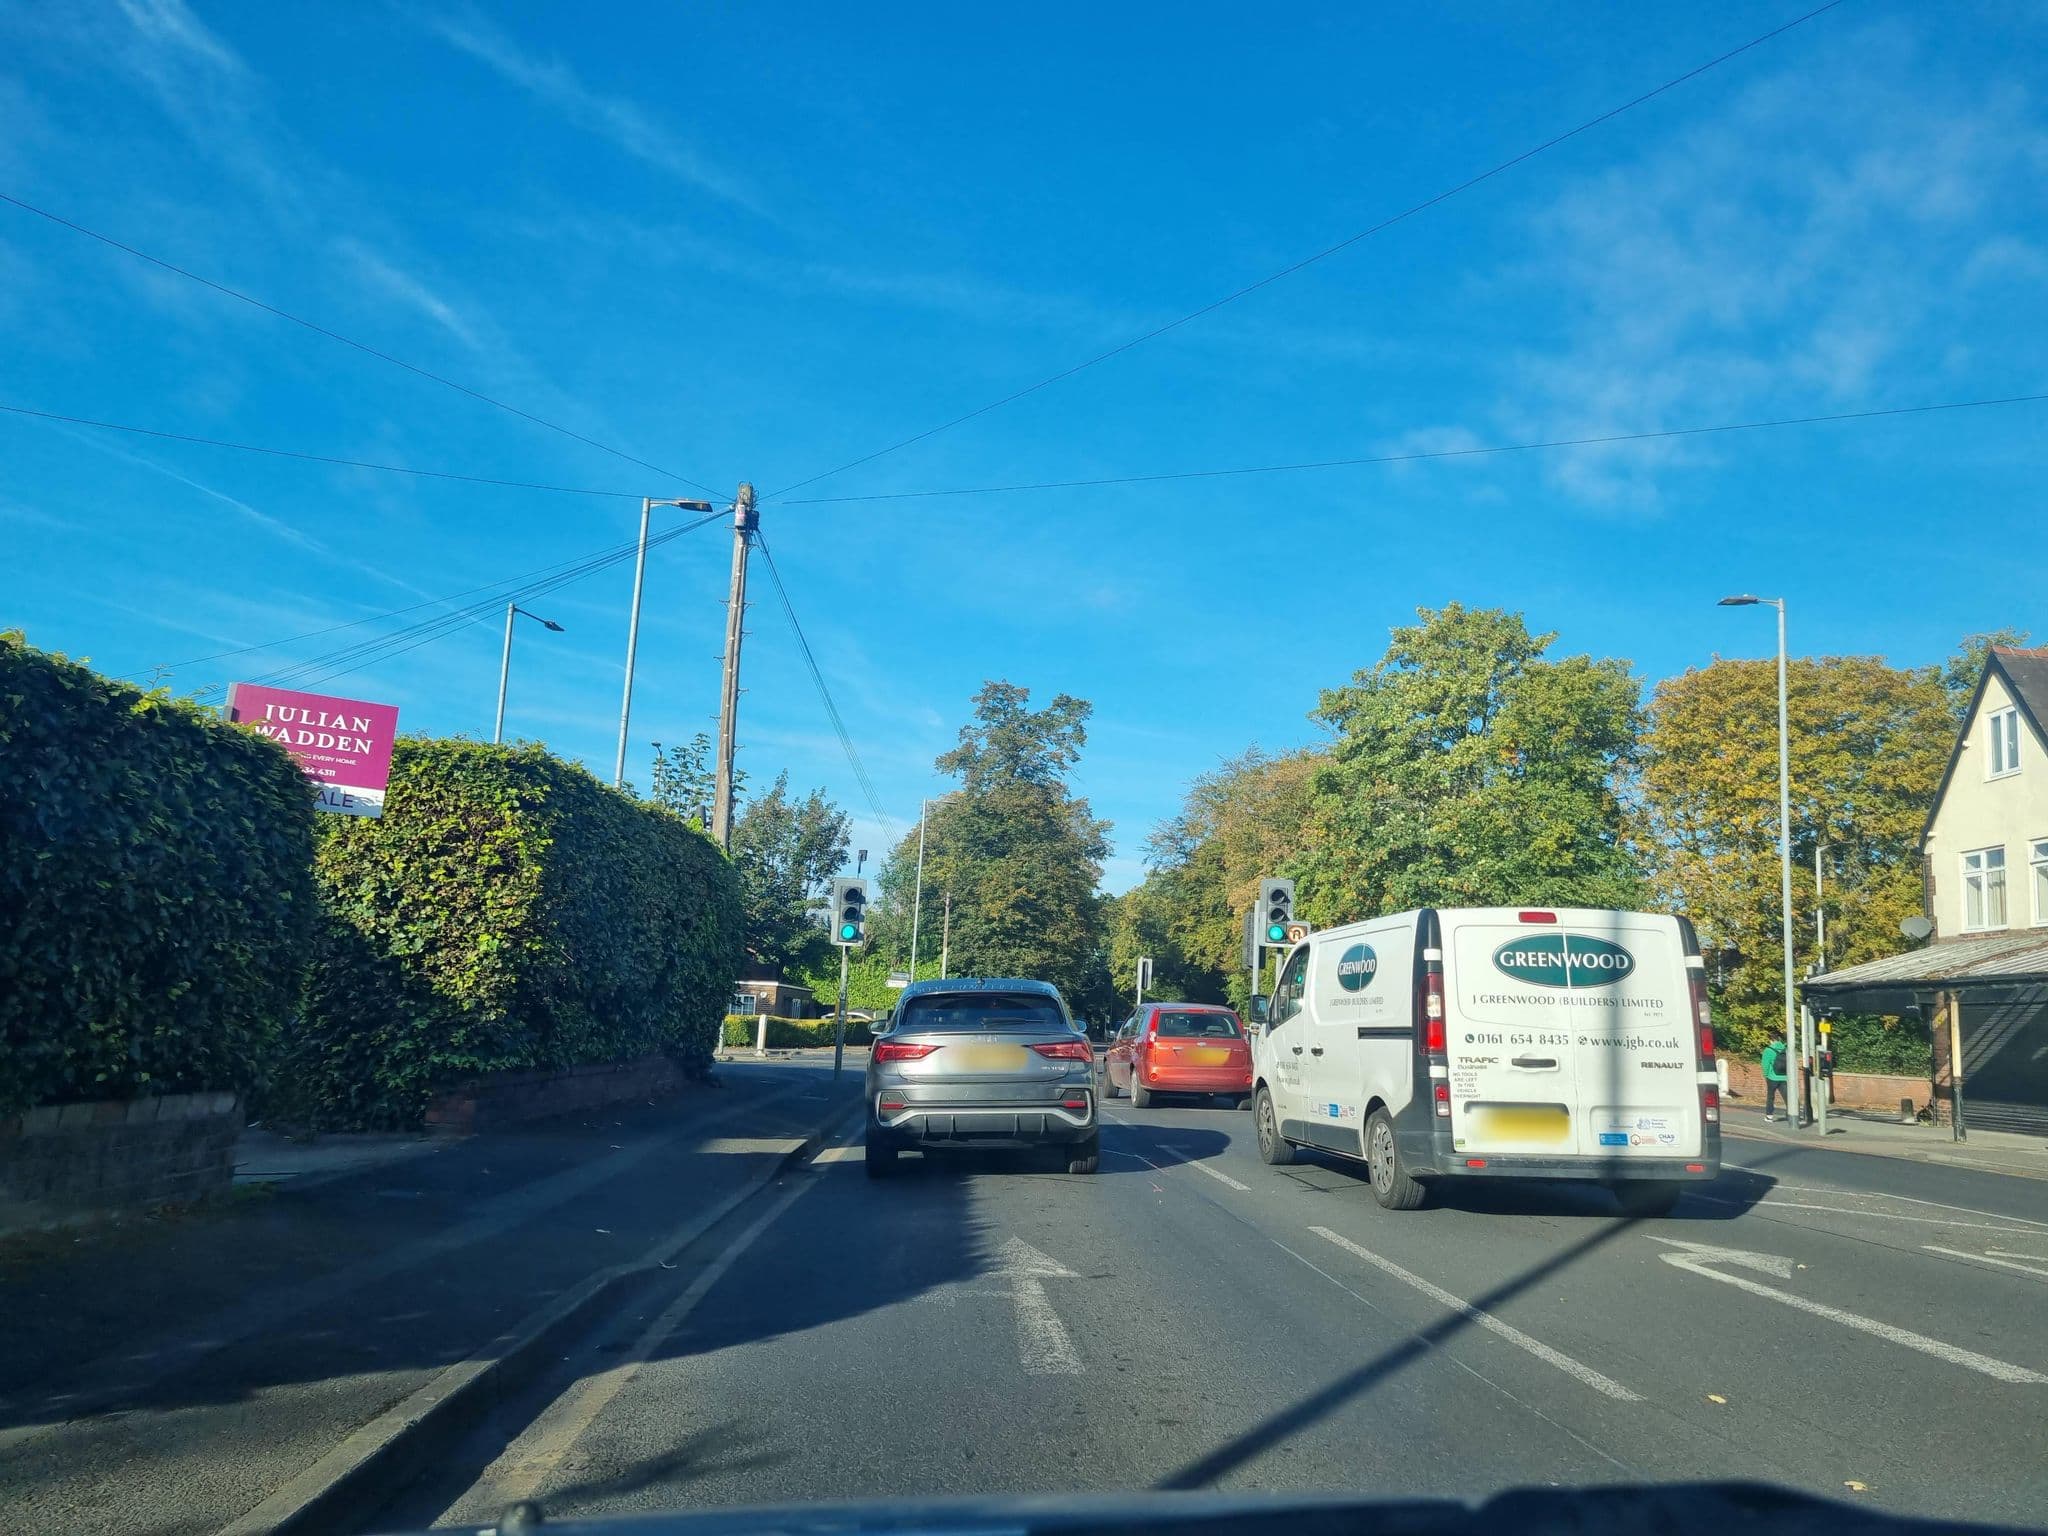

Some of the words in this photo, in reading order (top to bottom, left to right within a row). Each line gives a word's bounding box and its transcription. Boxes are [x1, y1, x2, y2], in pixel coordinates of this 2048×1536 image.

[265, 703, 372, 734] JULIAN
[254, 725, 373, 755] WADDEN
[312, 754, 336, 763] EVERY
[335, 758, 358, 766] HOME
[1338, 958, 1376, 976] GREENWOOD
[1499, 951, 1629, 970] GREENWOOD
[1480, 994, 1556, 1006] GREENWOOD
[1559, 995, 1618, 1008] (BUILDERS)
[1621, 997, 1664, 1009] LIMITED
[1477, 1033, 1503, 1045] 0161
[1510, 1034, 1533, 1045] 654
[1539, 1034, 1569, 1046] 8435
[1590, 1035, 1680, 1051] www.jgb.co.uk
[1457, 1056, 1499, 1064] TRAFIC
[1640, 1061, 1684, 1069] RENAULT
